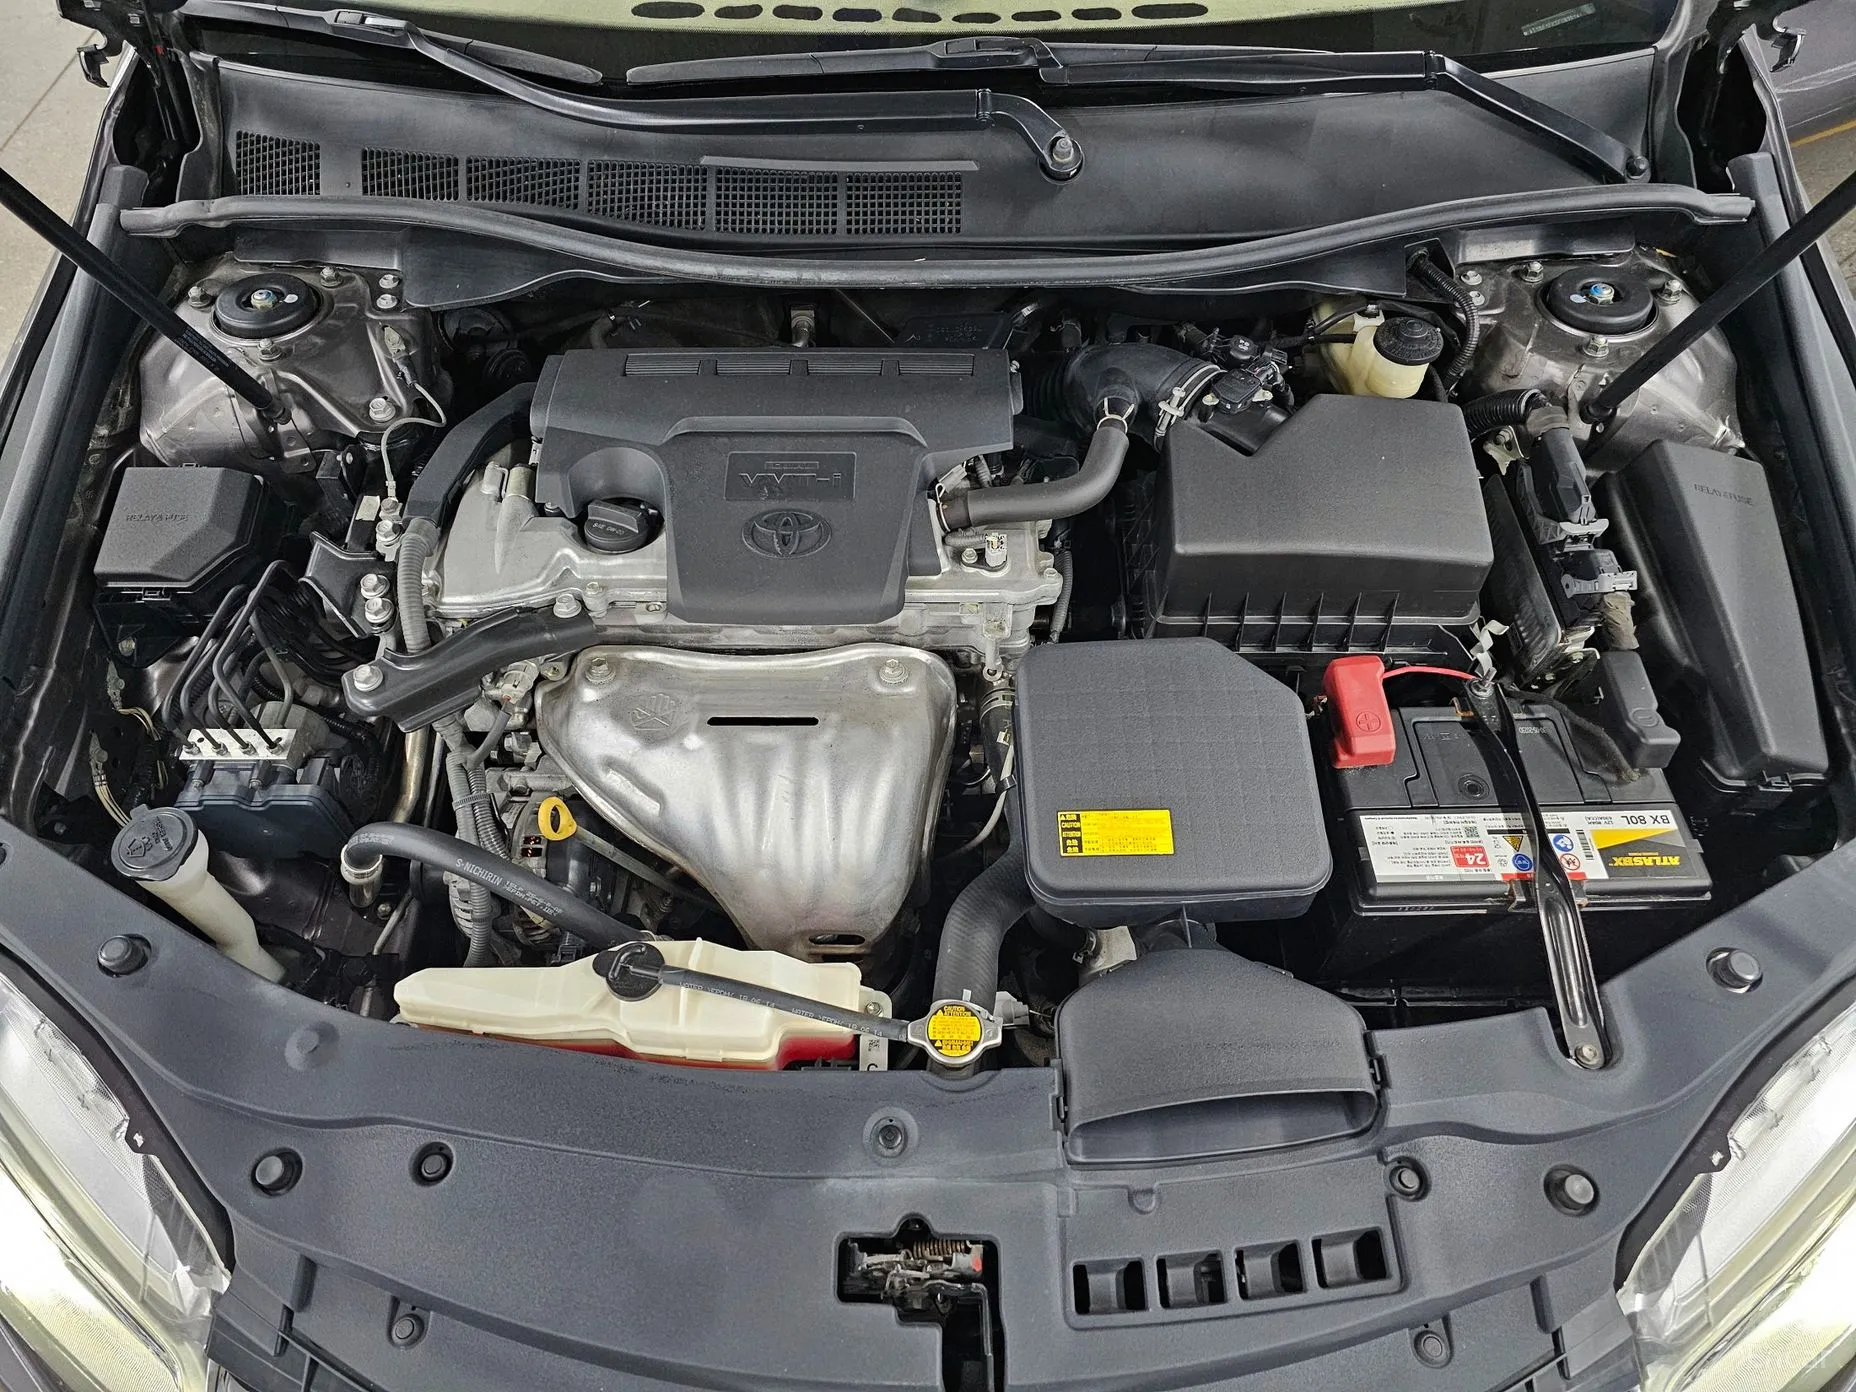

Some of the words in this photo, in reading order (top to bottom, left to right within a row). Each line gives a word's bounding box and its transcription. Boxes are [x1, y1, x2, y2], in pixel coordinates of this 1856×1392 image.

[1621, 815, 1647, 826] 80L
[1650, 814, 1671, 825] BX
[1465, 854, 1487, 865] 24
[1612, 856, 1681, 867] ATLASBX
